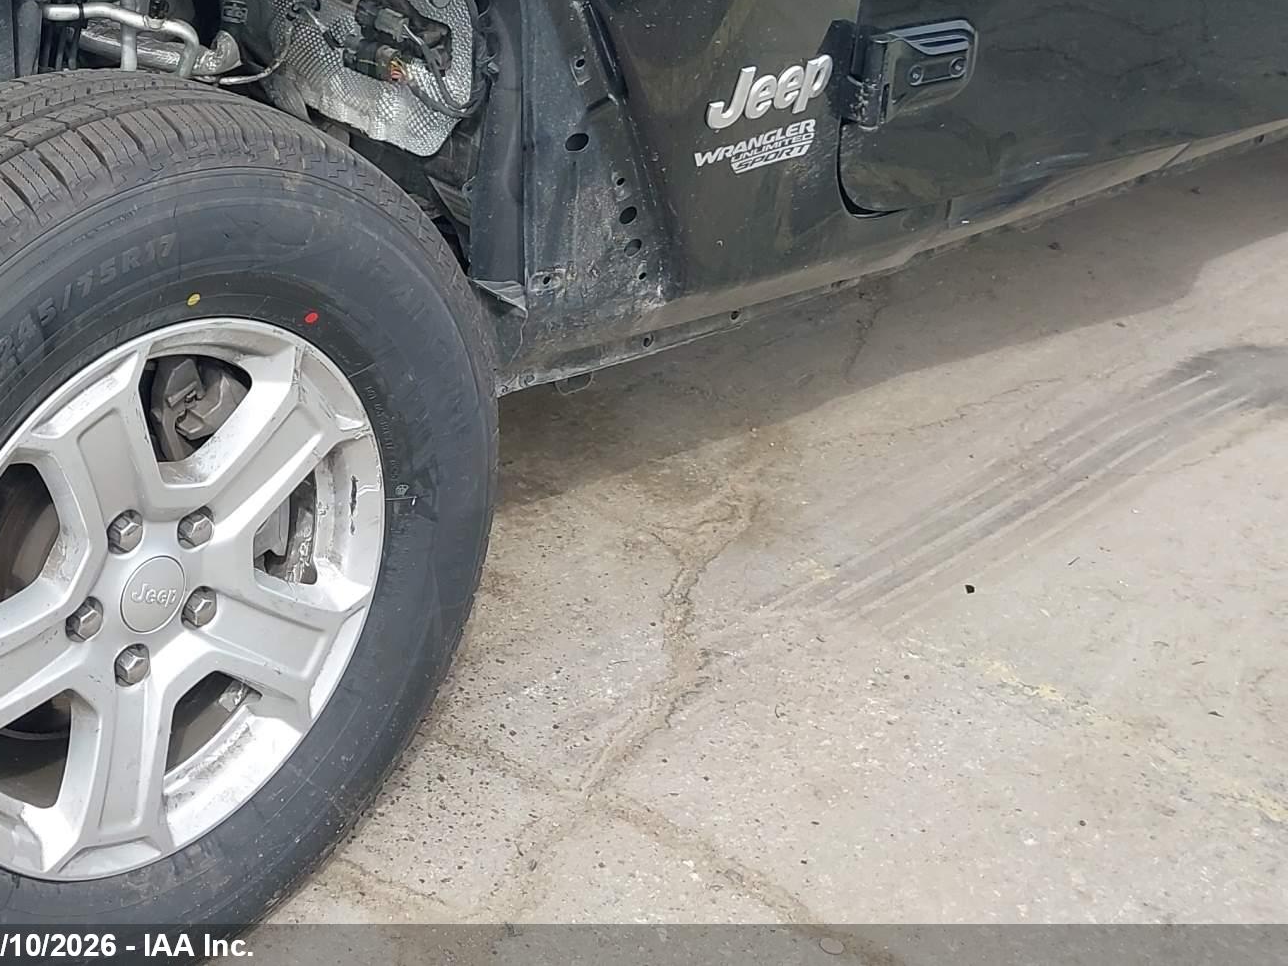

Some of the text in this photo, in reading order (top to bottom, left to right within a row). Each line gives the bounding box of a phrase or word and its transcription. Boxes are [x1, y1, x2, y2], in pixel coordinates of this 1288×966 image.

[706, 54, 833, 129] Jeep
[694, 119, 817, 167] WRANGLER
[730, 132, 814, 163] UNLIMITED
[732, 144, 811, 171] SPORT
[131, 583, 177, 608] Jeep
